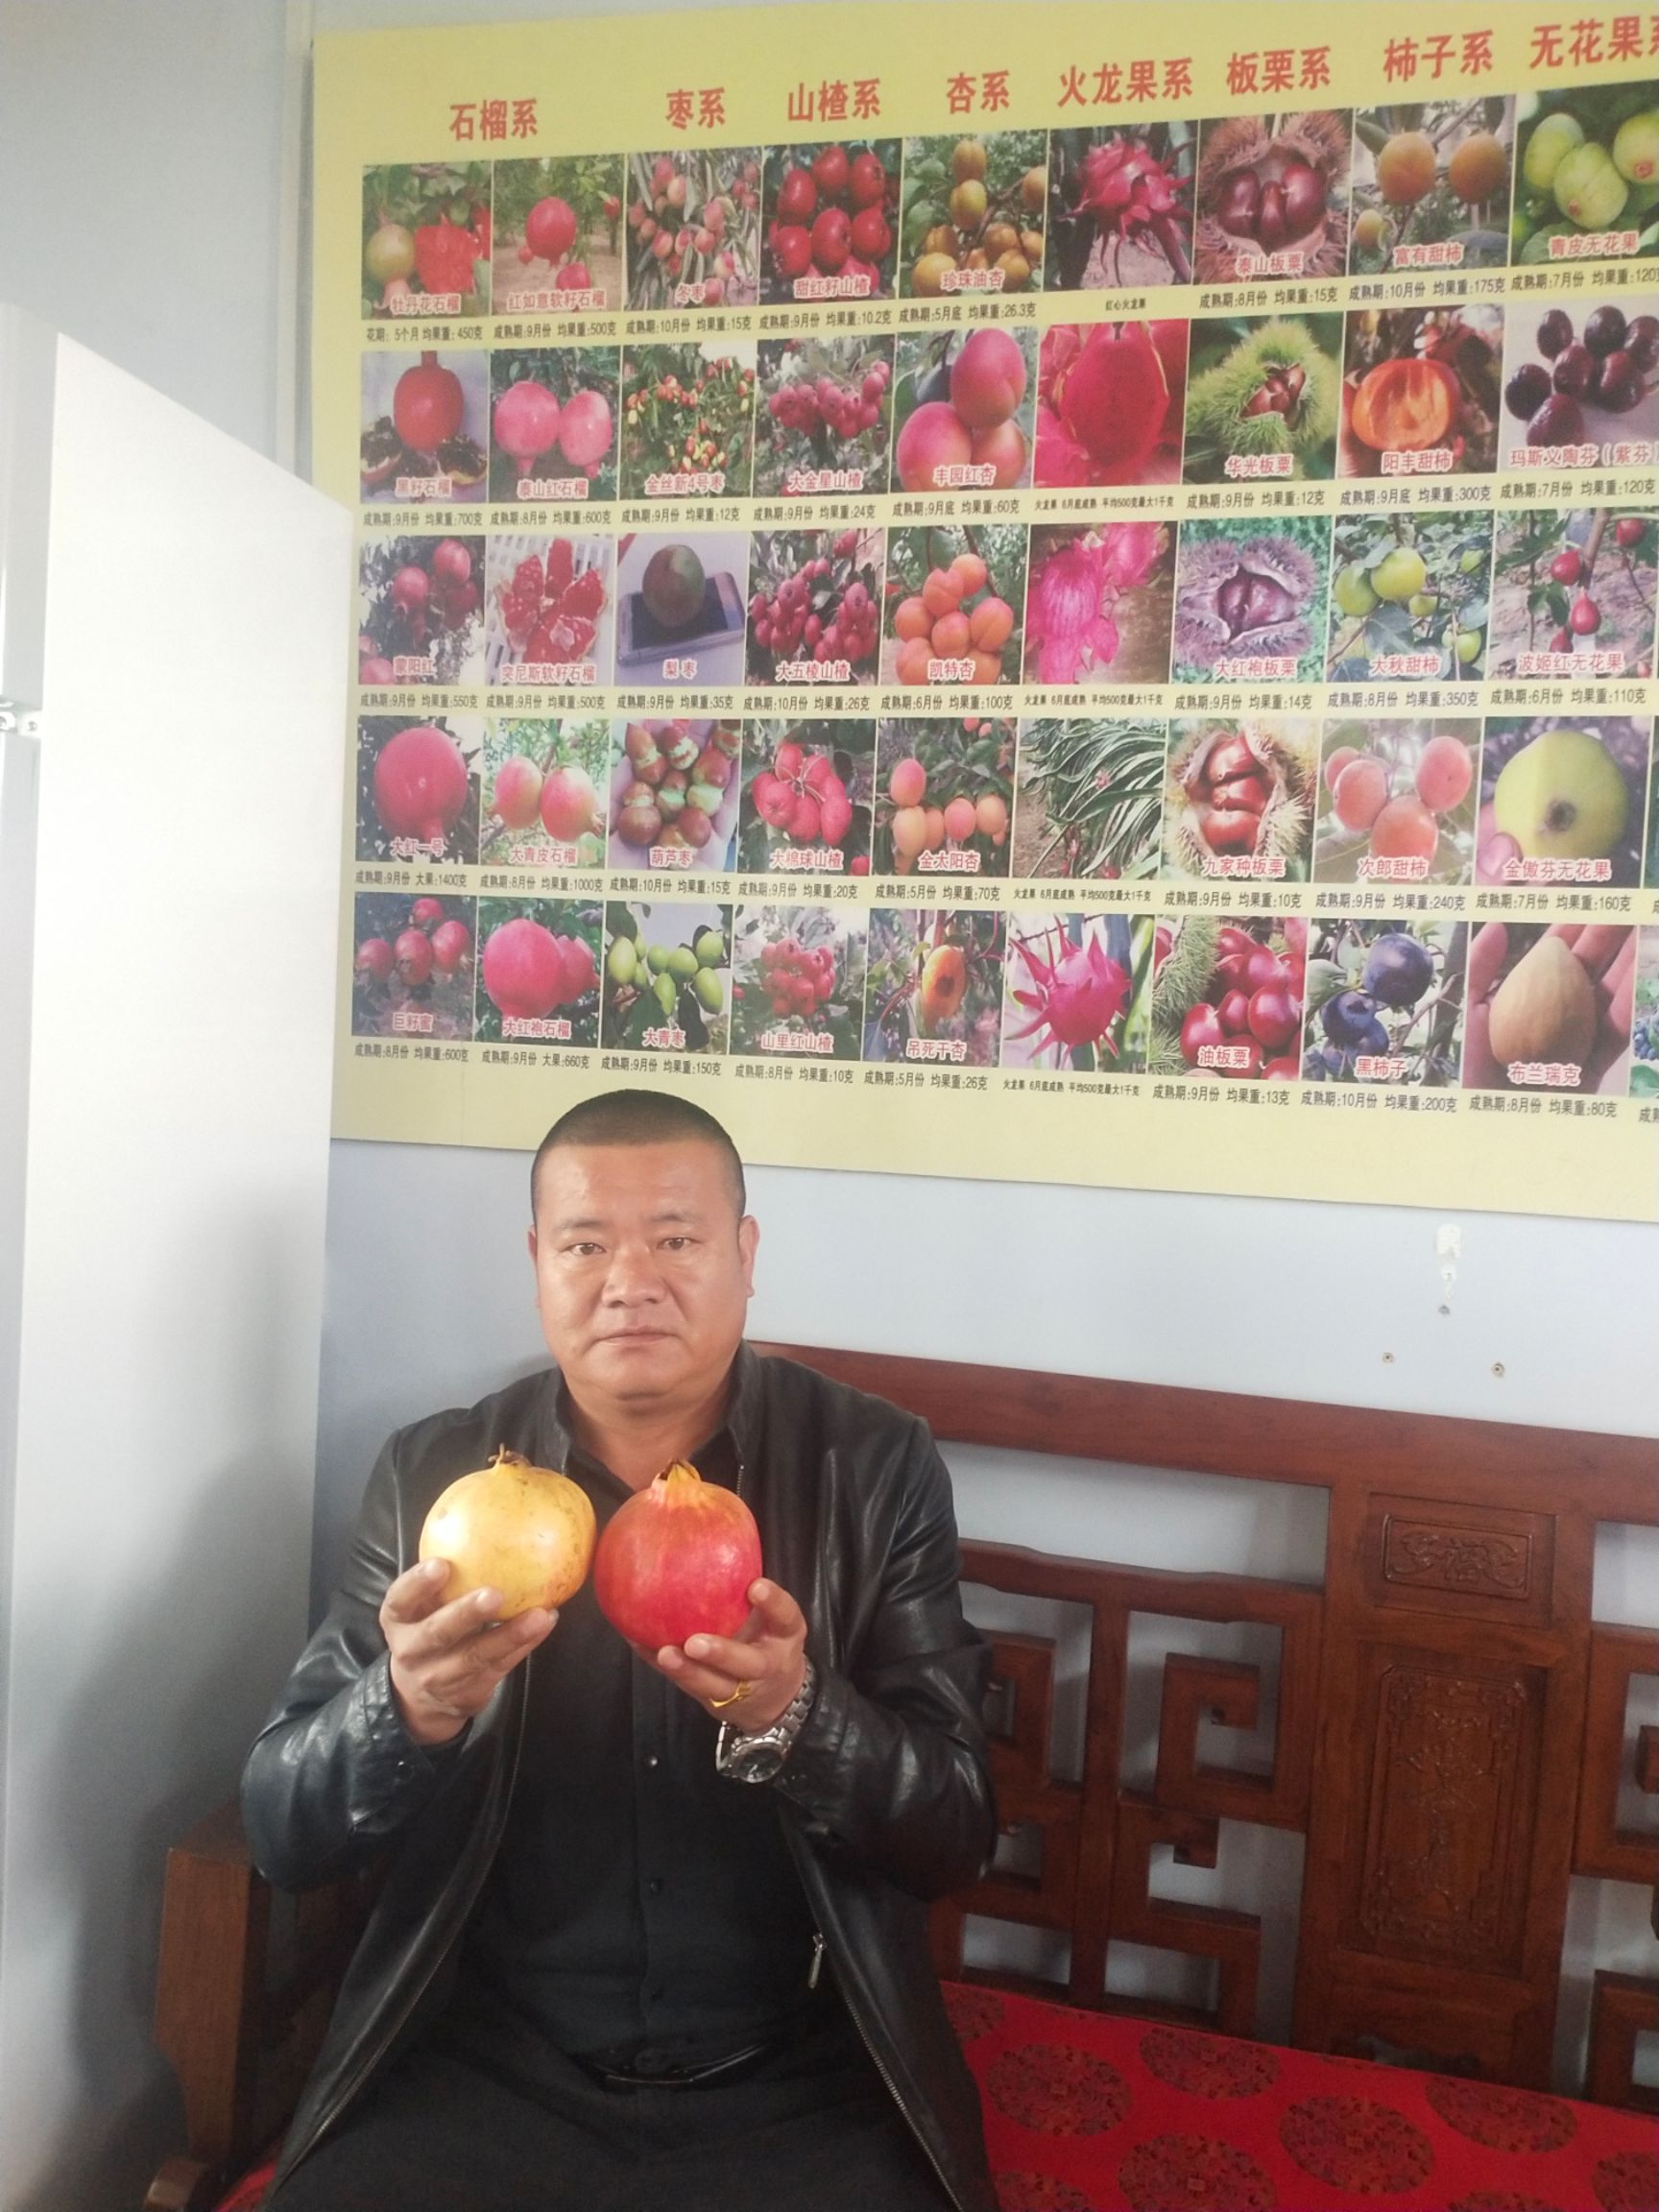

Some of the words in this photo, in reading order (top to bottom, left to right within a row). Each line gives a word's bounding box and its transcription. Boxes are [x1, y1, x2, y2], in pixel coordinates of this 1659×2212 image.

[1383, 30, 1494, 83] 柿子系
[1225, 46, 1332, 95] 板栗系
[947, 70, 1011, 113] 杏系
[1057, 58, 1193, 108] 火龙果系
[666, 87, 726, 130] 枣系
[787, 78, 881, 122] 山楂系
[449, 99, 538, 141] 石榴系
[1551, 233, 1638, 256] 青皮无花果
[1395, 244, 1462, 265] 富有甜柿
[943, 270, 1003, 289] 珍珠油杏
[508, 291, 605, 310] 红如意软籽石榴
[678, 284, 705, 302] 冬枣
[1382, 451, 1452, 471] 阳丰甜柿
[646, 473, 724, 493] 金丝新4号枣
[790, 471, 862, 491] 大金星山楂
[935, 466, 995, 485] 丰园红杏
[664, 661, 696, 678] 梨枣
[929, 661, 974, 679] 凯特杏
[1372, 656, 1439, 674] 大秋甜柿
[1519, 654, 1623, 671] 波姬红无花果
[502, 664, 594, 682] 突尼斯软籽石榴
[392, 838, 445, 854] 大红一号
[511, 847, 575, 863] 大青皮石榴
[651, 848, 692, 866] 葫芦枣
[920, 853, 979, 871] 金太阳杏
[1204, 856, 1285, 877] 九家种板栗
[1358, 859, 1428, 878] 次郎甜柿
[1505, 860, 1610, 880] 金傲芬无花果
[504, 1020, 570, 1038] 大红袍石榴
[643, 1029, 685, 1046] 大青枣
[762, 1034, 832, 1052] 山里红山楂
[907, 1041, 966, 1060] 吊死干杏
[1357, 1058, 1407, 1078] 黑柿子
[1510, 1063, 1580, 1085] 布兰瑞克
